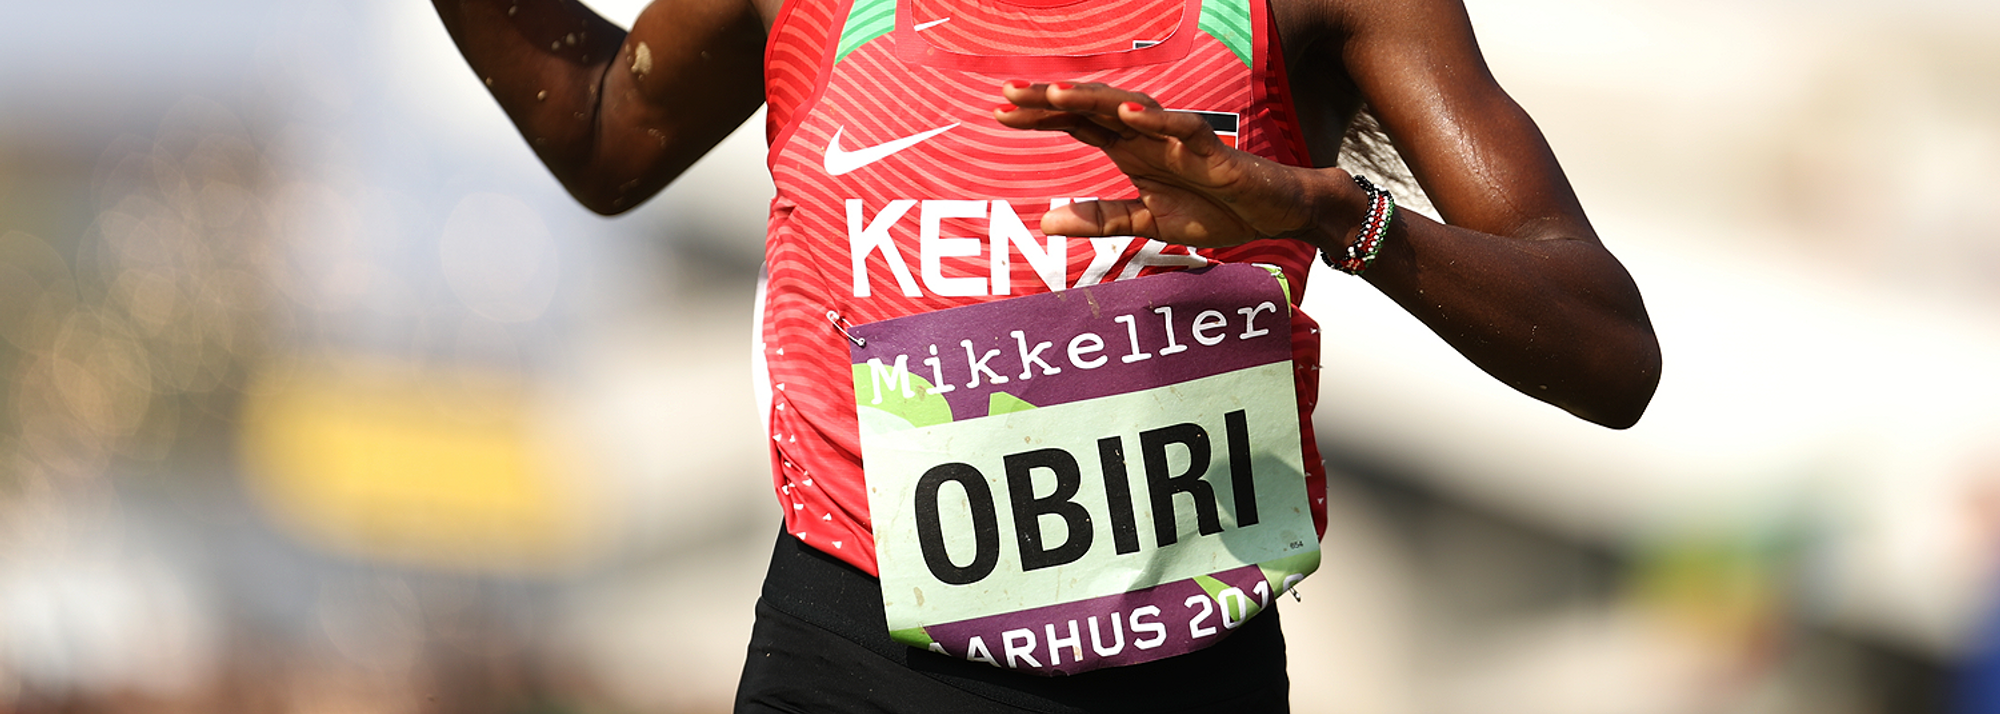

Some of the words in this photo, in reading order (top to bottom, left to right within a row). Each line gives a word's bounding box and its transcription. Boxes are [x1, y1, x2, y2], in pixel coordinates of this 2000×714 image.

[866, 300, 1277, 404] Mikkeller
[913, 408, 1260, 586] OBIRI
[1183, 573, 1304, 639] 201
